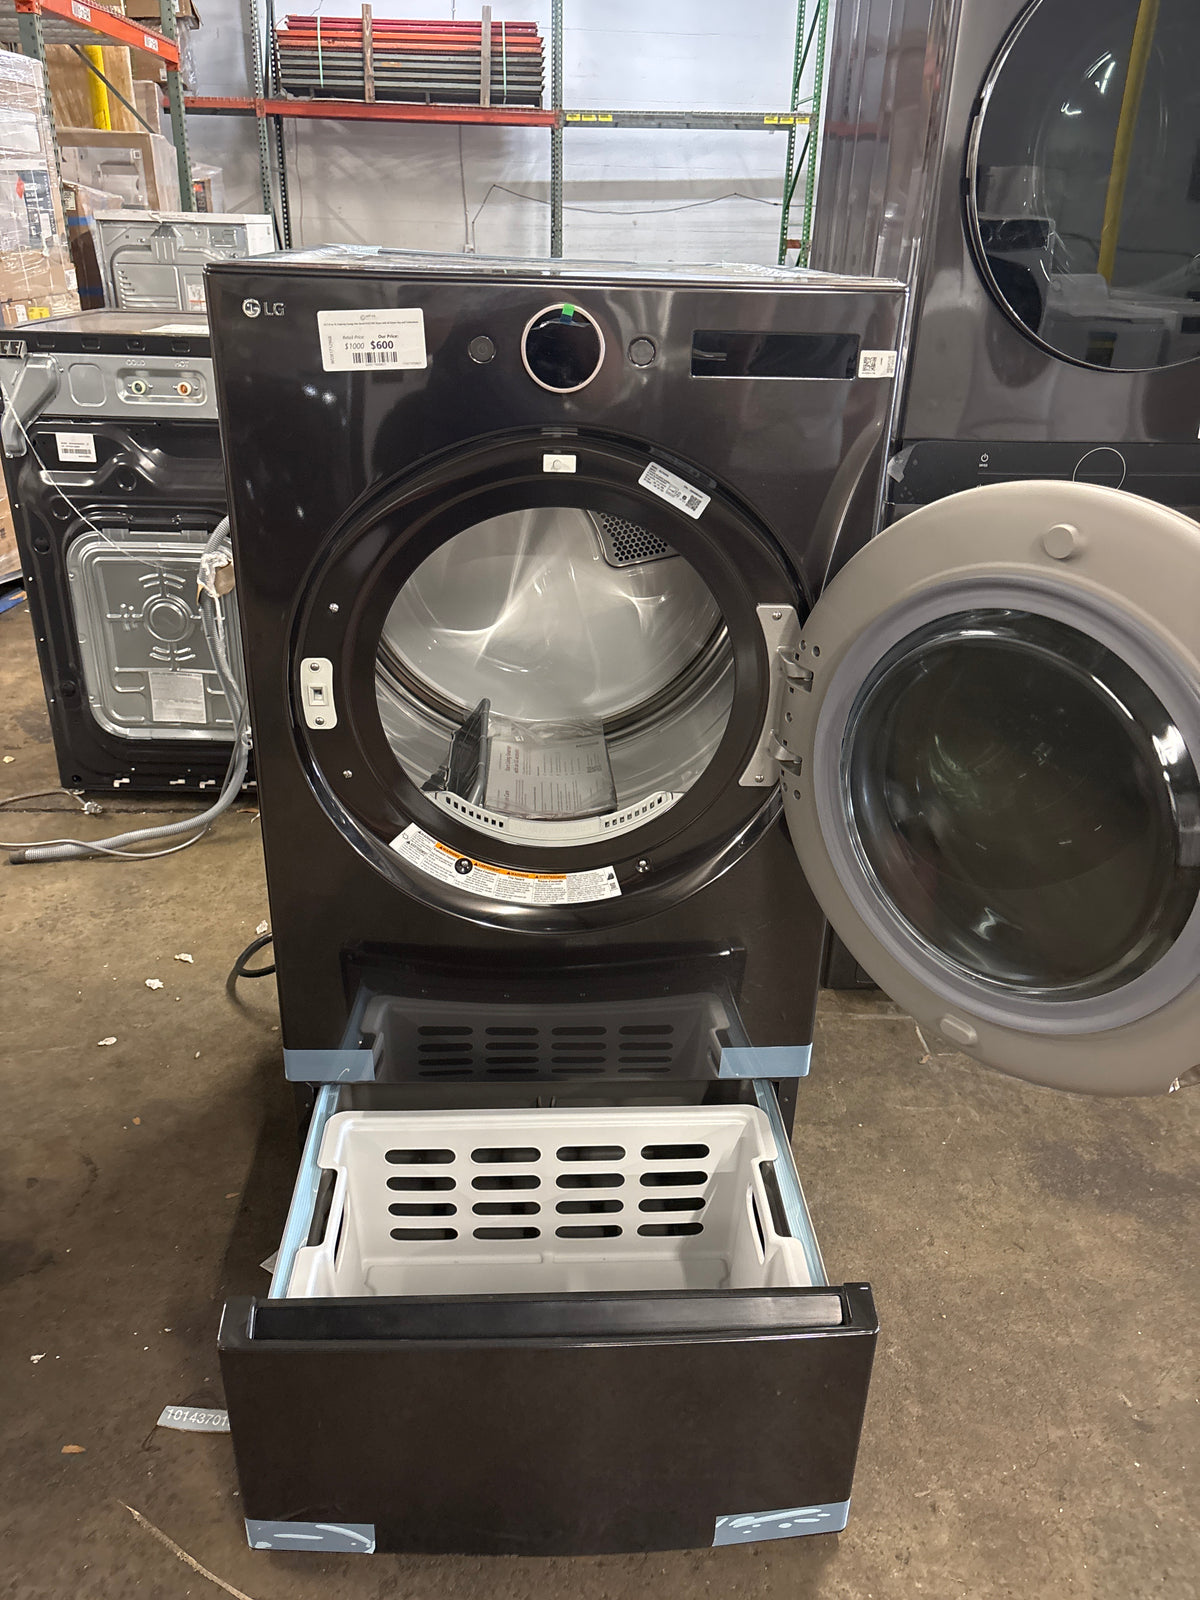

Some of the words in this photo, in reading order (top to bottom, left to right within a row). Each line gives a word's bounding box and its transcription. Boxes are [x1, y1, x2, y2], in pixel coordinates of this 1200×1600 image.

[263, 301, 285, 316] LG
[344, 342, 365, 350] $1000
[370, 340, 394, 350] $600
[167, 1408, 230, 1427] 10143701
